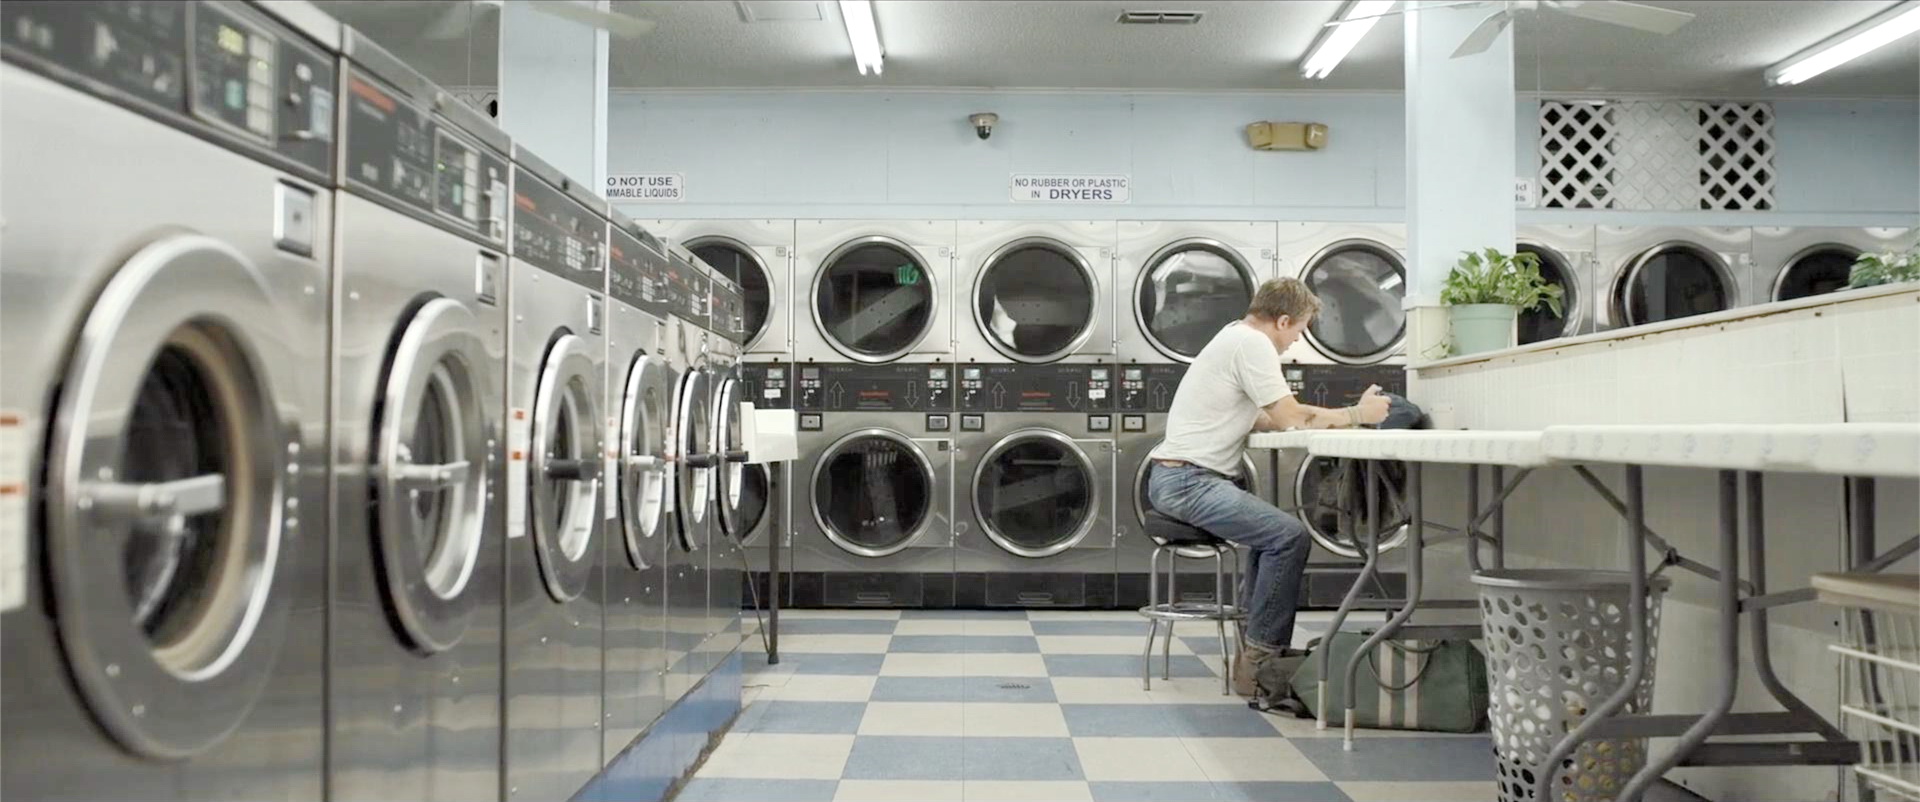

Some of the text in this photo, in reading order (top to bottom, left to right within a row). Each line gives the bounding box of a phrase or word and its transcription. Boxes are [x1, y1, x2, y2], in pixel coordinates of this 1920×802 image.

[620, 177, 645, 186] NOT
[648, 177, 673, 186] USE
[1015, 178, 1126, 188] NO RUBBER OR PLASTIC
[644, 188, 678, 198] LIQUIDS
[1031, 189, 1113, 200] IN DRYERS
